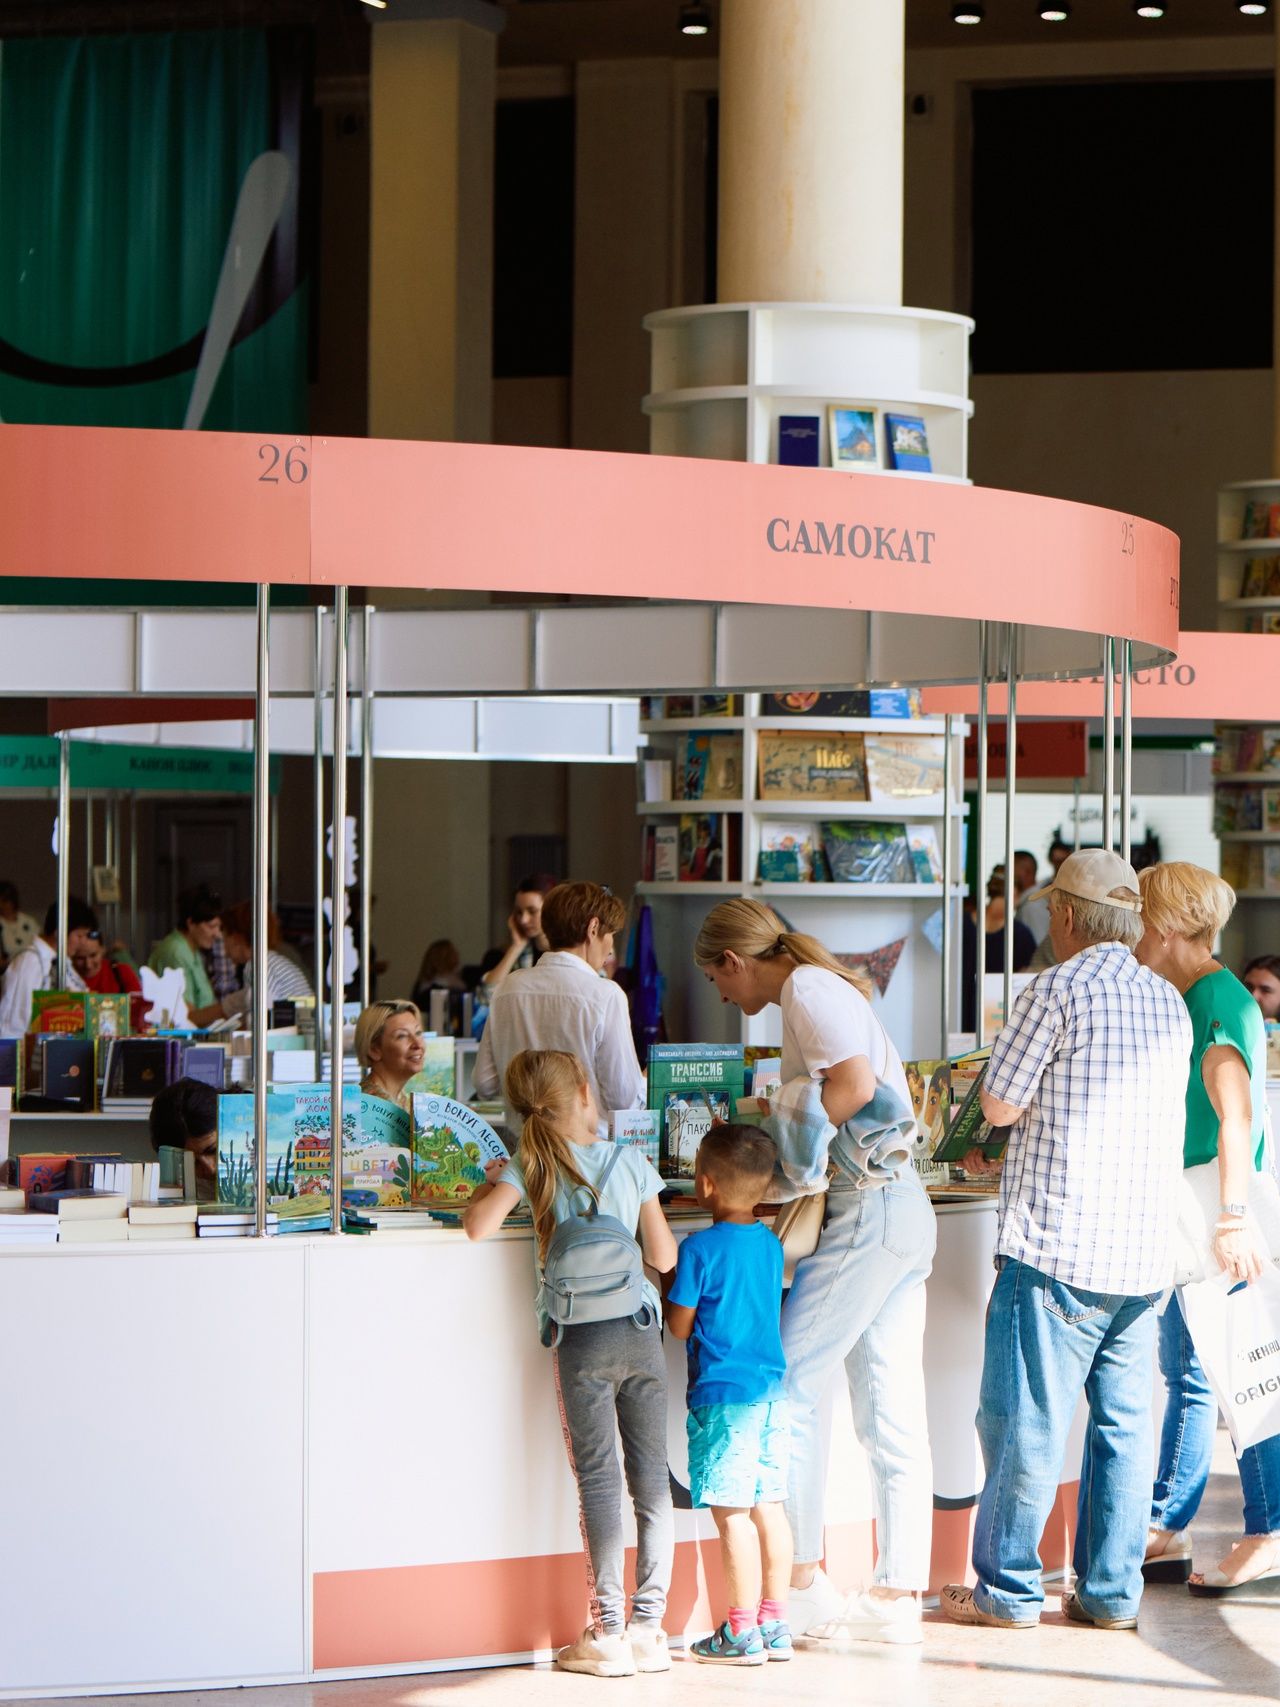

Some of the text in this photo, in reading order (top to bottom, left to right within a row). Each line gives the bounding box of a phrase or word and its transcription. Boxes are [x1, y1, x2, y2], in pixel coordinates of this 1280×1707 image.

[257, 443, 310, 485] 26
[767, 518, 935, 564] САМОКАТ
[1120, 520, 1136, 557] 25
[670, 1062, 723, 1077] ТРАНССИБ
[306, 1105, 329, 1113] ДОМ
[444, 1101, 479, 1129] ВОКРУГ
[687, 1123, 711, 1135] ПАКС
[350, 1159, 399, 1172] ЦВЕТА
